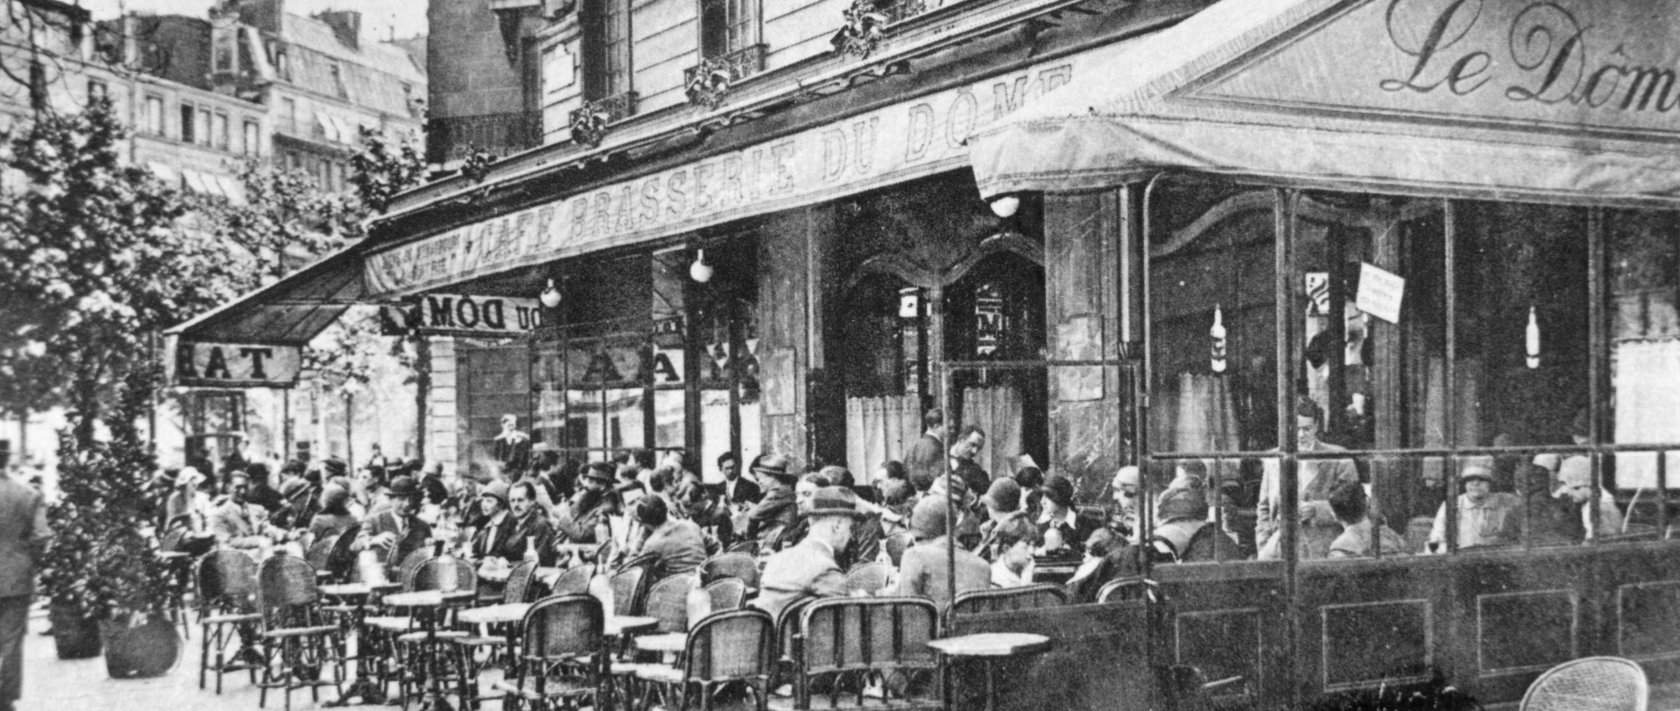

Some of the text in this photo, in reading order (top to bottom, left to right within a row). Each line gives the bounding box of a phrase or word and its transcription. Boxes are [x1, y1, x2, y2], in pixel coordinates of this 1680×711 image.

[1379, 0, 1491, 95] Le
[571, 140, 795, 240] BRASSERIE
[822, 116, 879, 181] DU
